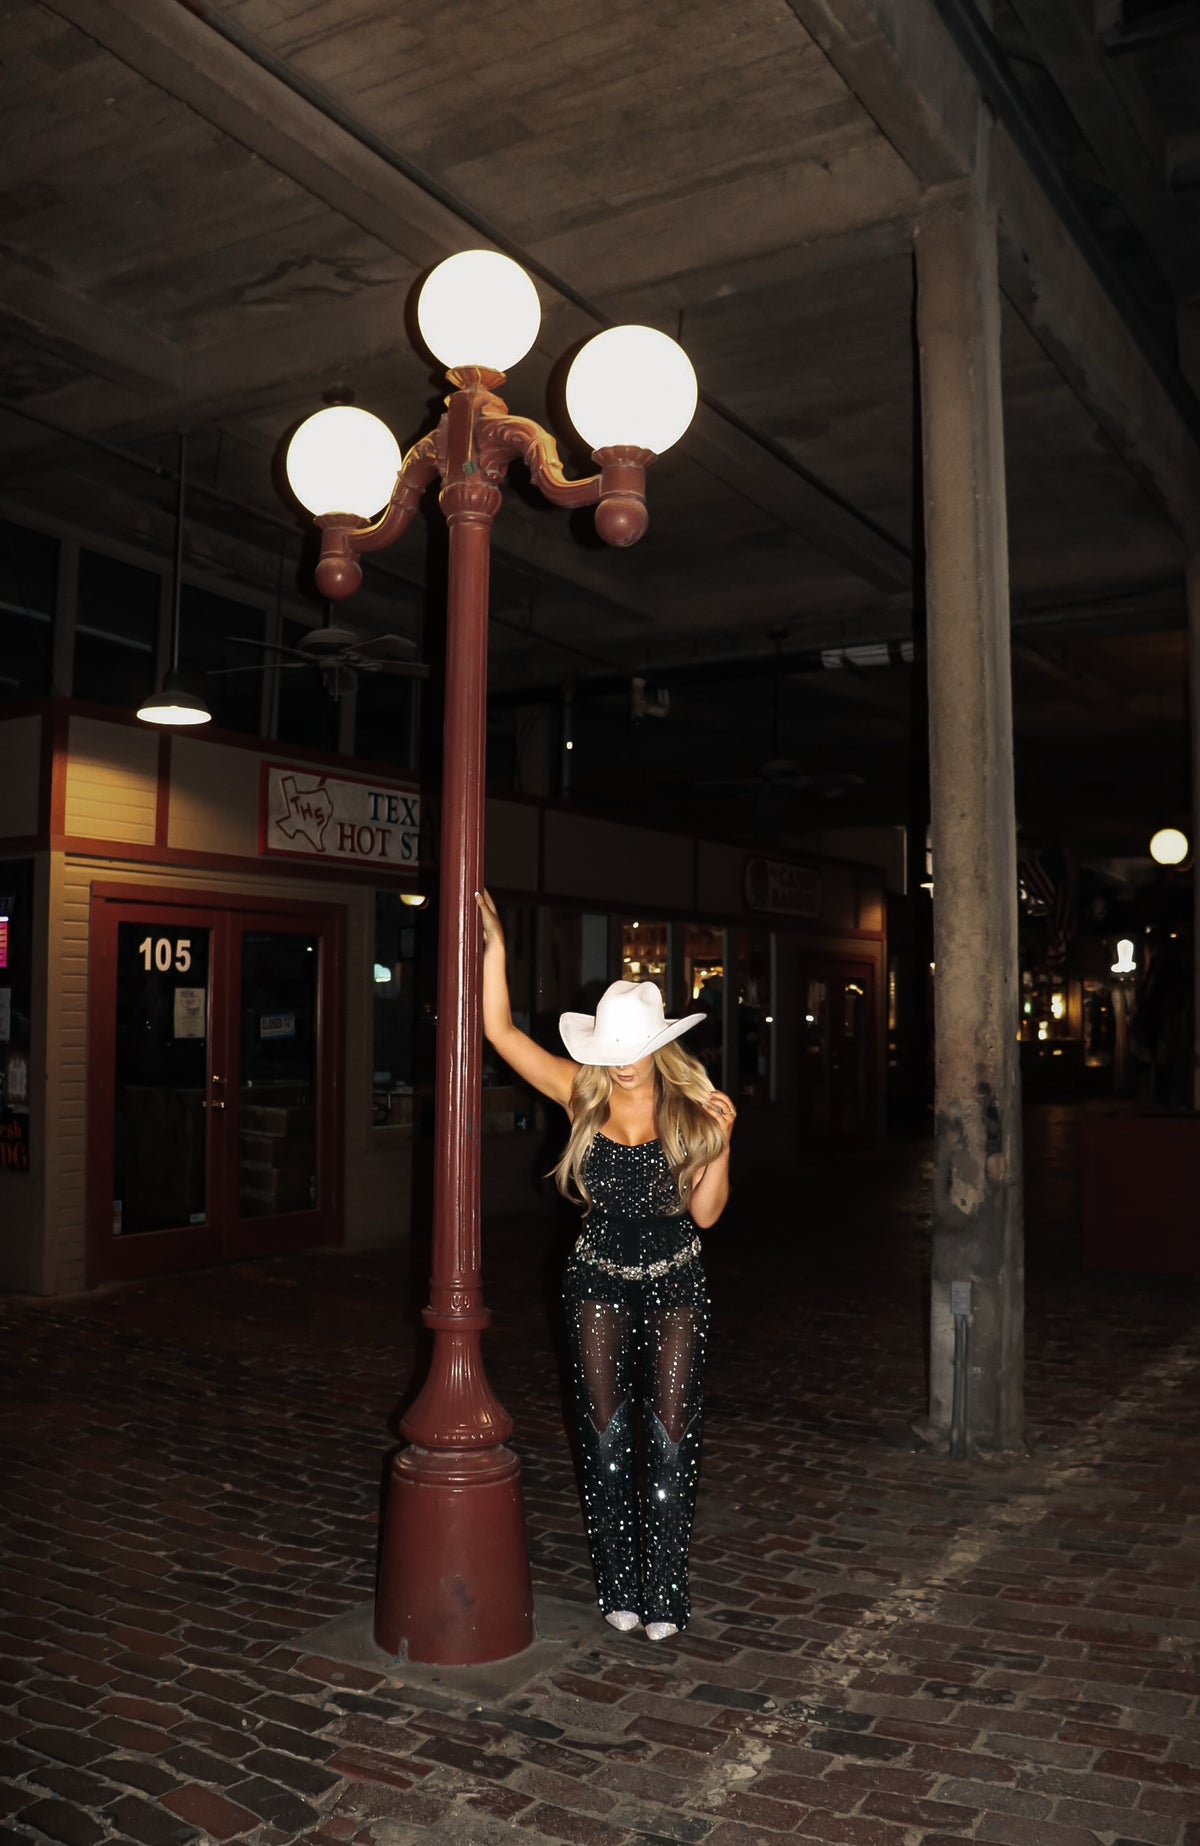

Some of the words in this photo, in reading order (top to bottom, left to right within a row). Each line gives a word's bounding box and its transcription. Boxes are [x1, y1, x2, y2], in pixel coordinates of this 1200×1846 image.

[290, 796, 325, 826] THS
[337, 822, 392, 857] HOT
[139, 937, 191, 972] 105
